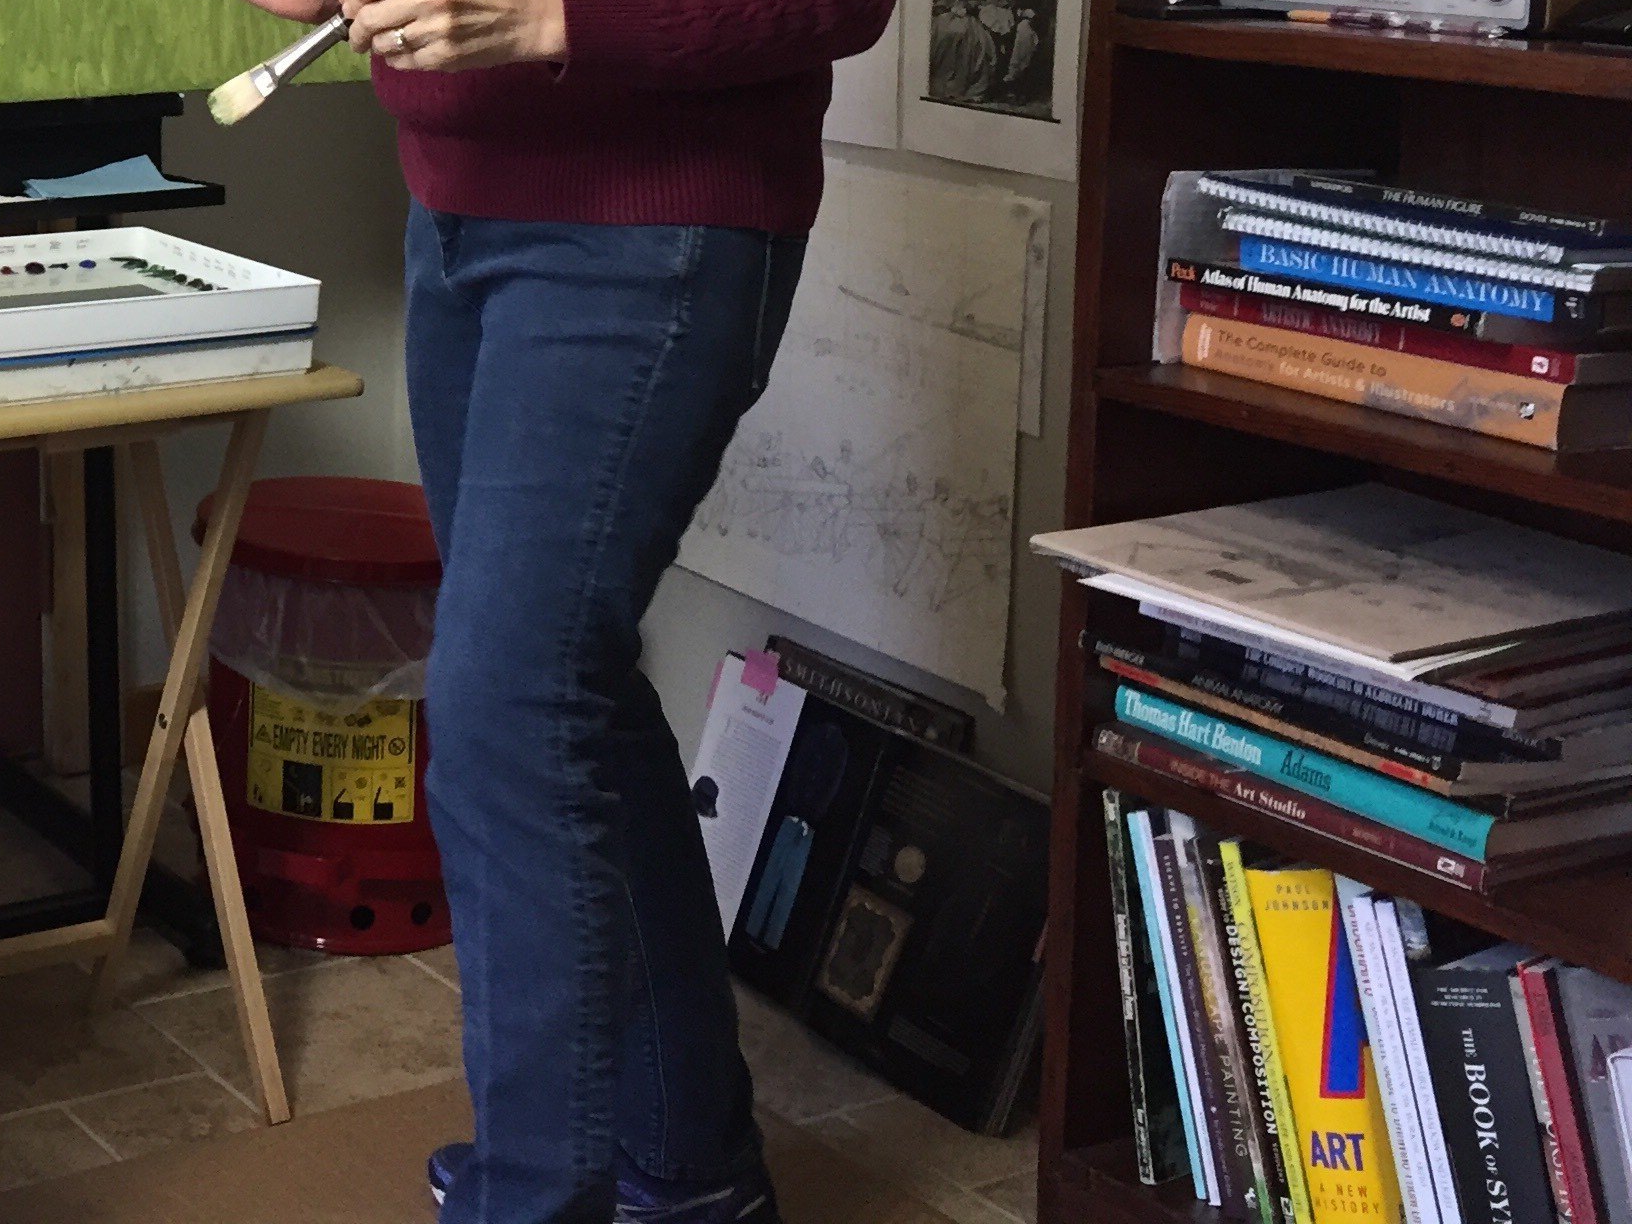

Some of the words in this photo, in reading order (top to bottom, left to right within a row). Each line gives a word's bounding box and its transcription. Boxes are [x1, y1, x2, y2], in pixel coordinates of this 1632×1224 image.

[1171, 262, 1196, 281] Peck
[1260, 243, 1326, 272] BASIC
[1331, 253, 1416, 289] HUMAN
[1425, 273, 1549, 311] ANATOMY
[1200, 268, 1232, 287] Atlas
[1232, 274, 1247, 291] of
[1247, 275, 1291, 299] Human
[1291, 284, 1351, 312] Anatomy
[1349, 293, 1367, 311] for
[1369, 296, 1390, 316] the
[1390, 301, 1431, 323] Artist
[1218, 329, 1243, 347] The
[1246, 337, 1317, 363] Complete
[1321, 352, 1365, 373] Guide
[1370, 362, 1387, 377] to
[1279, 361, 1300, 376] for
[1302, 368, 1350, 389] Artists
[273, 724, 308, 755] EMPTY
[312, 731, 348, 759] EVERY
[351, 734, 387, 761] NIGHT
[1124, 688, 1178, 732] Thomas
[1177, 709, 1211, 744] Hart
[1211, 721, 1262, 765] Benton
[1280, 750, 1332, 792] Adams
[1233, 782, 1257, 802] Art
[1258, 789, 1306, 820] Studio
[1265, 900, 1329, 911] JOHNSON
[1276, 884, 1310, 894] PAUL
[1225, 923, 1249, 992] DESIGN
[1241, 1001, 1277, 1136] COMPOSITION
[1462, 1028, 1477, 1058] THE
[1216, 1053, 1249, 1159] PAINTING
[1464, 1062, 1499, 1150] BOOK
[1310, 1130, 1364, 1171] ART
[1485, 1154, 1498, 1175] OF
[1315, 1197, 1380, 1214] HISTORY
[1336, 1184, 1368, 1198] NEW
